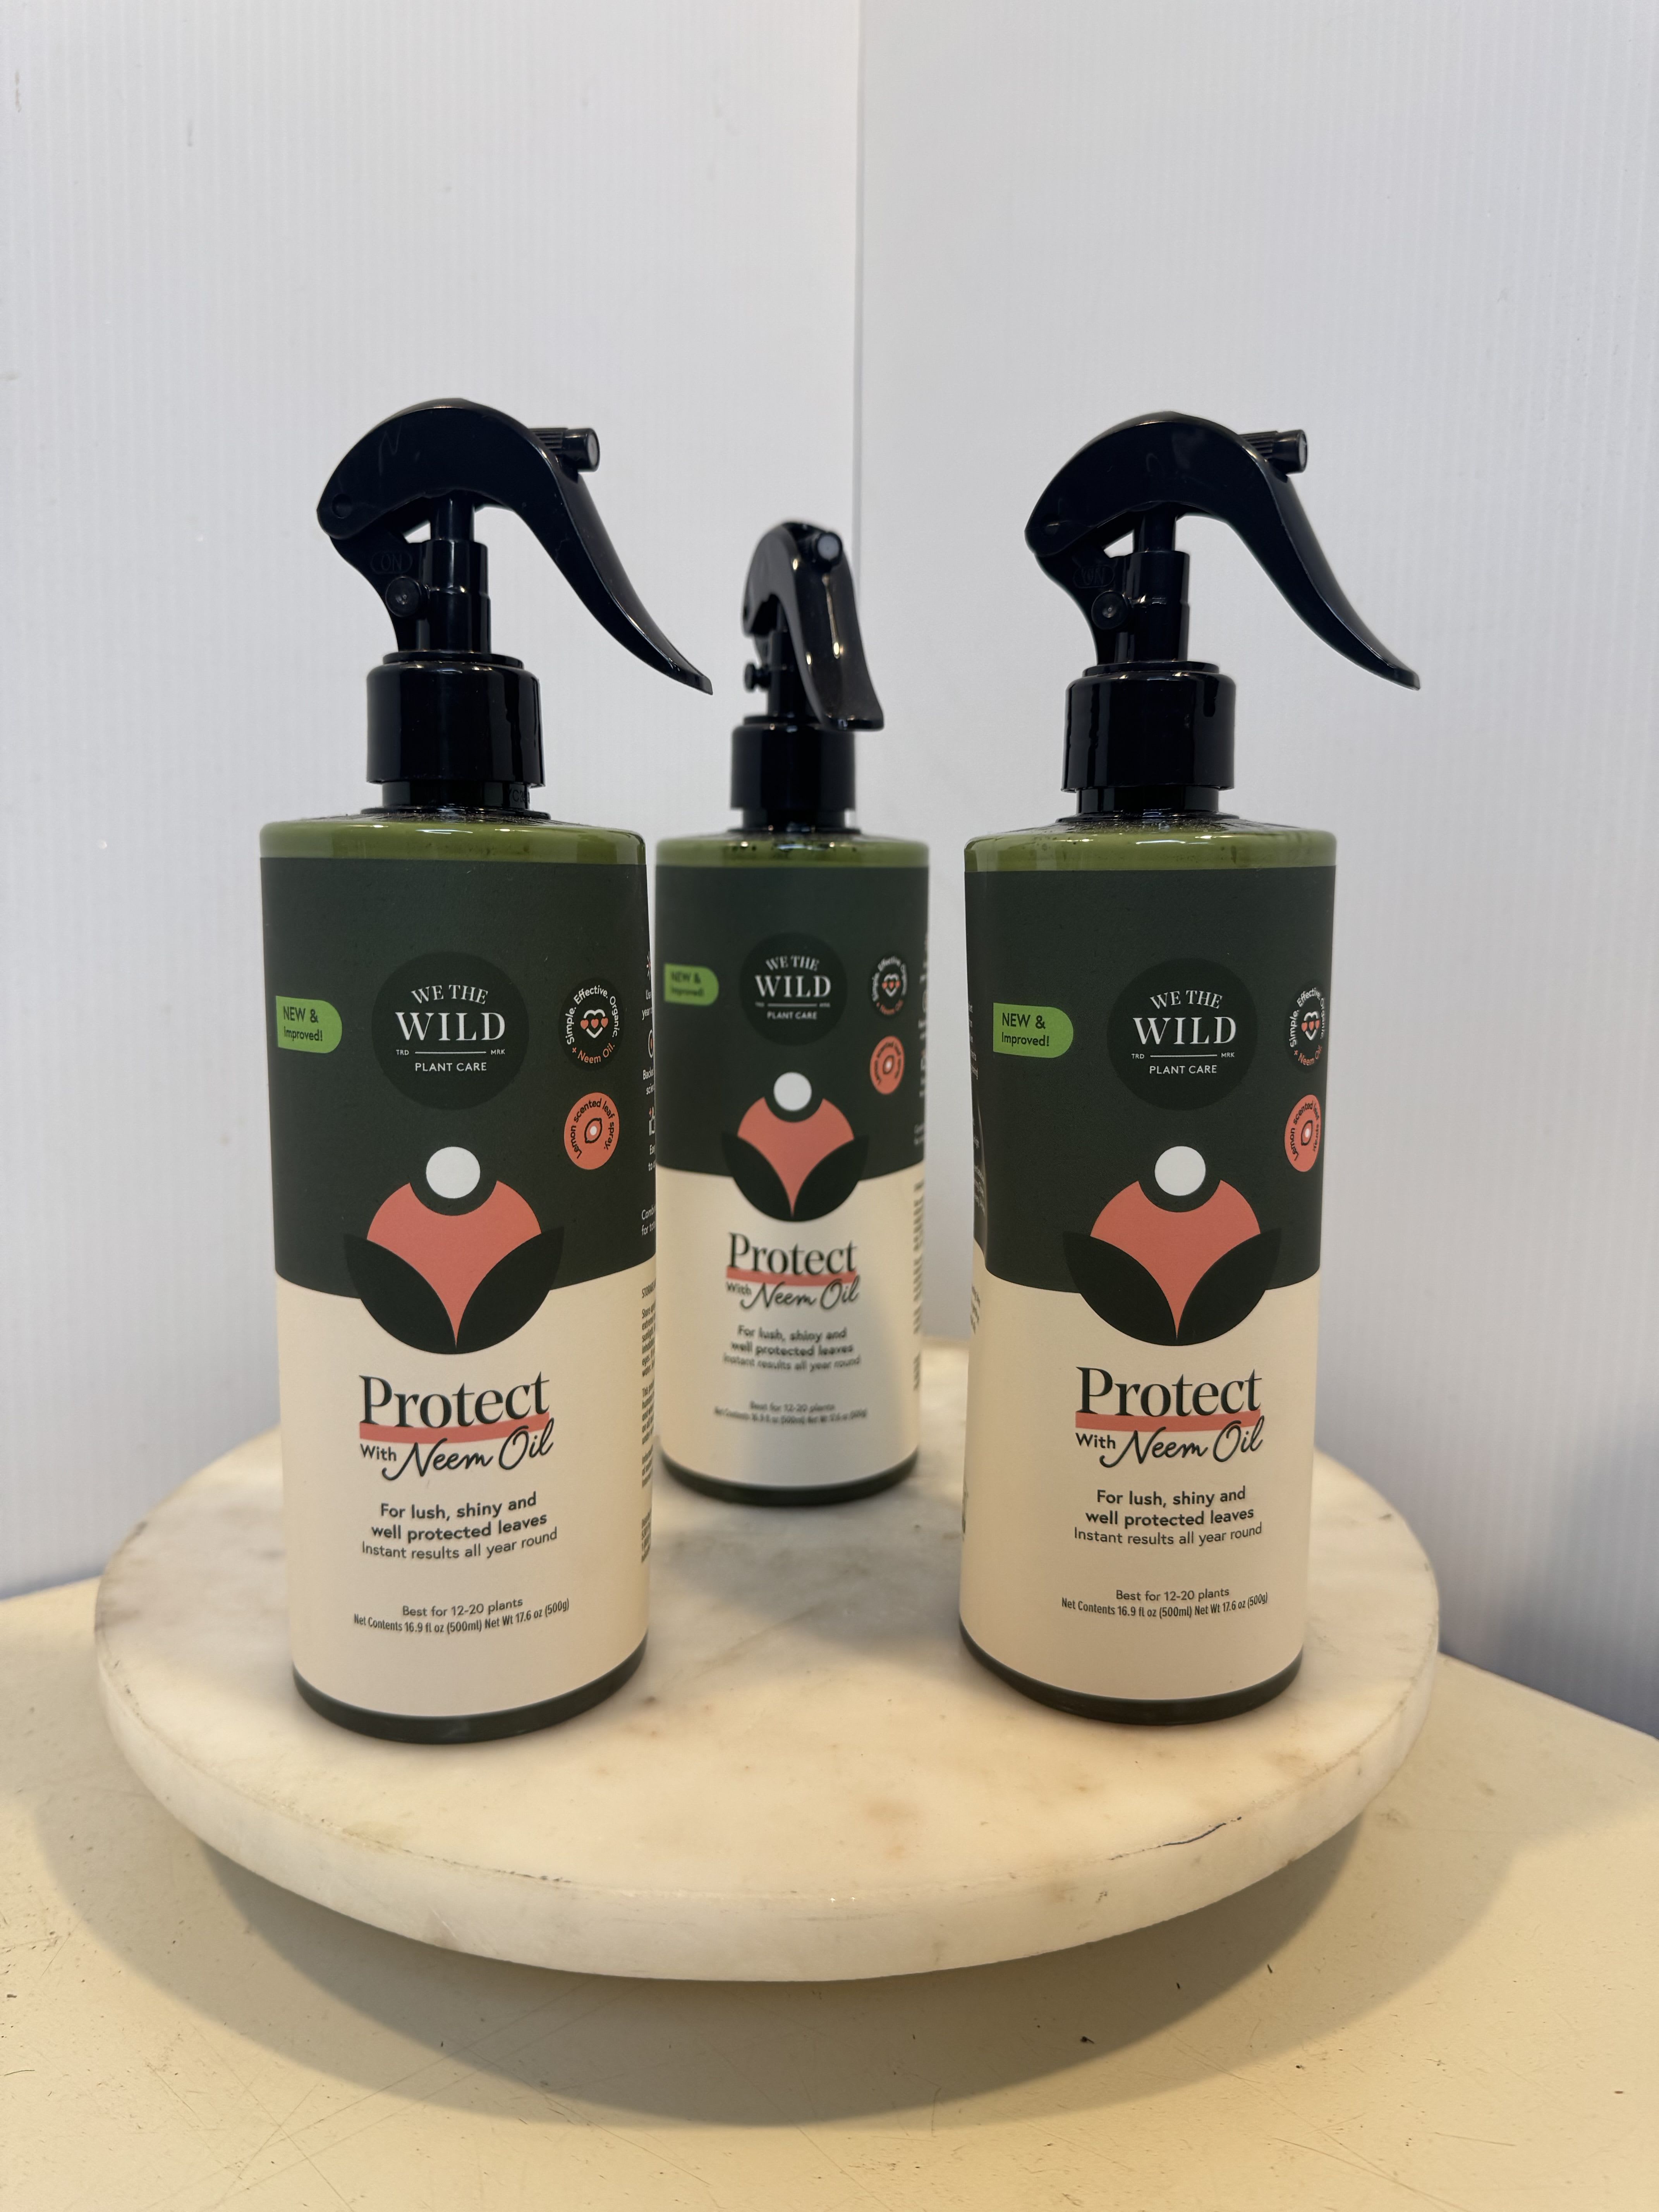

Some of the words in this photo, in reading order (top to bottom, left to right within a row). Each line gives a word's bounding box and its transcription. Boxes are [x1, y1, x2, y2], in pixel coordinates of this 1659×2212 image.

[766, 955, 788, 970] WE
[411, 985, 444, 1004] WE
[449, 985, 488, 1004] THE
[755, 975, 831, 997] WILD
[1150, 991, 1181, 1009] WE
[1186, 990, 1223, 1009] THE
[283, 1006, 306, 1022] NEW
[310, 1009, 318, 1023] &
[395, 1012, 505, 1041] WILD
[565, 1007, 576, 1044] Simple.
[573, 985, 608, 1005] Effective.
[610, 996, 619, 1037] Organic.
[767, 1010, 793, 1020] PLANT
[795, 1011, 817, 1020] CARE
[1002, 1012, 1030, 1028] NEW
[1035, 1015, 1046, 1029] &
[1289, 1010, 1300, 1047] Simple.
[1297, 987, 1321, 1007] Effective.
[284, 1026, 323, 1041] Improved!
[1002, 1032, 1049, 1047] Improved!
[1132, 1017, 1236, 1044] WILD
[577, 1050, 601, 1063] Neem
[603, 1043, 615, 1058] Oil.
[1298, 1053, 1315, 1065] Neem
[415, 1063, 452, 1072] PLANT
[457, 1062, 486, 1071] CARE
[1150, 1066, 1185, 1074] PLANT
[1189, 1065, 1217, 1074] CARE
[574, 1098, 602, 1123] scented
[602, 1101, 615, 1119] leaf
[1293, 1100, 1313, 1125] scented
[570, 1125, 582, 1159] Lemon
[604, 1122, 614, 1150] spray.
[1290, 1128, 1299, 1161] Lemon
[728, 1232, 858, 1276] Protect
[726, 1281, 752, 1295] With
[740, 1281, 816, 1311] Neem
[820, 1275, 860, 1310] Oil
[738, 1325, 755, 1337] For
[790, 1327, 821, 1343] shiny
[826, 1327, 847, 1340] and
[756, 1344, 814, 1357] protected
[818, 1343, 854, 1356] leaves
[359, 1371, 550, 1428] Protect
[1075, 1366, 1262, 1417] Protect
[360, 1443, 397, 1462] With
[382, 1438, 493, 1480] Neem
[498, 1417, 554, 1470] Oil
[1075, 1432, 1116, 1449] With
[1099, 1426, 1208, 1468] Neem
[1213, 1415, 1264, 1462] Oil
[381, 1503, 405, 1518] For
[412, 1504, 450, 1521] lush,
[457, 1502, 502, 1518] shiny
[508, 1491, 536, 1511] and
[1097, 1490, 1123, 1504] For
[1129, 1491, 1167, 1508] lush,
[1173, 1491, 1214, 1507] shiny
[1220, 1485, 1245, 1502] and
[371, 1524, 401, 1539] well
[408, 1522, 491, 1543] protected
[498, 1513, 547, 1534] leaves
[1085, 1511, 1118, 1525] well
[1125, 1511, 1204, 1528] protected
[1211, 1509, 1254, 1523] leaves
[362, 1541, 406, 1559] Instant
[411, 1546, 459, 1559] results
[465, 1543, 481, 1557] all
[487, 1540, 517, 1558] year
[521, 1526, 557, 1549] round
[1074, 1527, 1123, 1543] Instant
[1128, 1532, 1174, 1545] results
[1179, 1531, 1194, 1544] all
[1199, 1531, 1226, 1546] year
[1230, 1522, 1262, 1539] round
[1061, 1597, 1075, 1610] Net
[1078, 1601, 1115, 1615] Contents
[1117, 1605, 1136, 1616] 16.9
[1139, 1606, 1145, 1617] fl
[1147, 1609, 1156, 1617] oz
[1159, 1606, 1192, 1619] (500ml)
[1195, 1605, 1208, 1616] Net
[1210, 1604, 1220, 1614] Wt
[1223, 1601, 1237, 1613] 17.6
[1238, 1600, 1245, 1609] oz
[1247, 1592, 1268, 1609] (500g)
[1116, 1590, 1141, 1601] Best
[1145, 1590, 1161, 1601] for
[1164, 1590, 1195, 1601] 12-20
[1198, 1588, 1230, 1602] plants
[354, 1613, 366, 1626] Net
[368, 1617, 403, 1632] Contents
[404, 1621, 423, 1632] 16.9
[426, 1621, 431, 1632] fl
[434, 1625, 444, 1633] oz
[447, 1619, 482, 1635] (500ml)
[485, 1620, 500, 1629] Net
[503, 1615, 513, 1626] Wt
[515, 1610, 531, 1622] 17.6
[534, 1609, 543, 1618] oz
[545, 1598, 570, 1618] (500g)
[403, 1605, 427, 1616] Best
[431, 1605, 448, 1616] for
[452, 1603, 484, 1615] 12-20
[488, 1599, 523, 1614] plants
